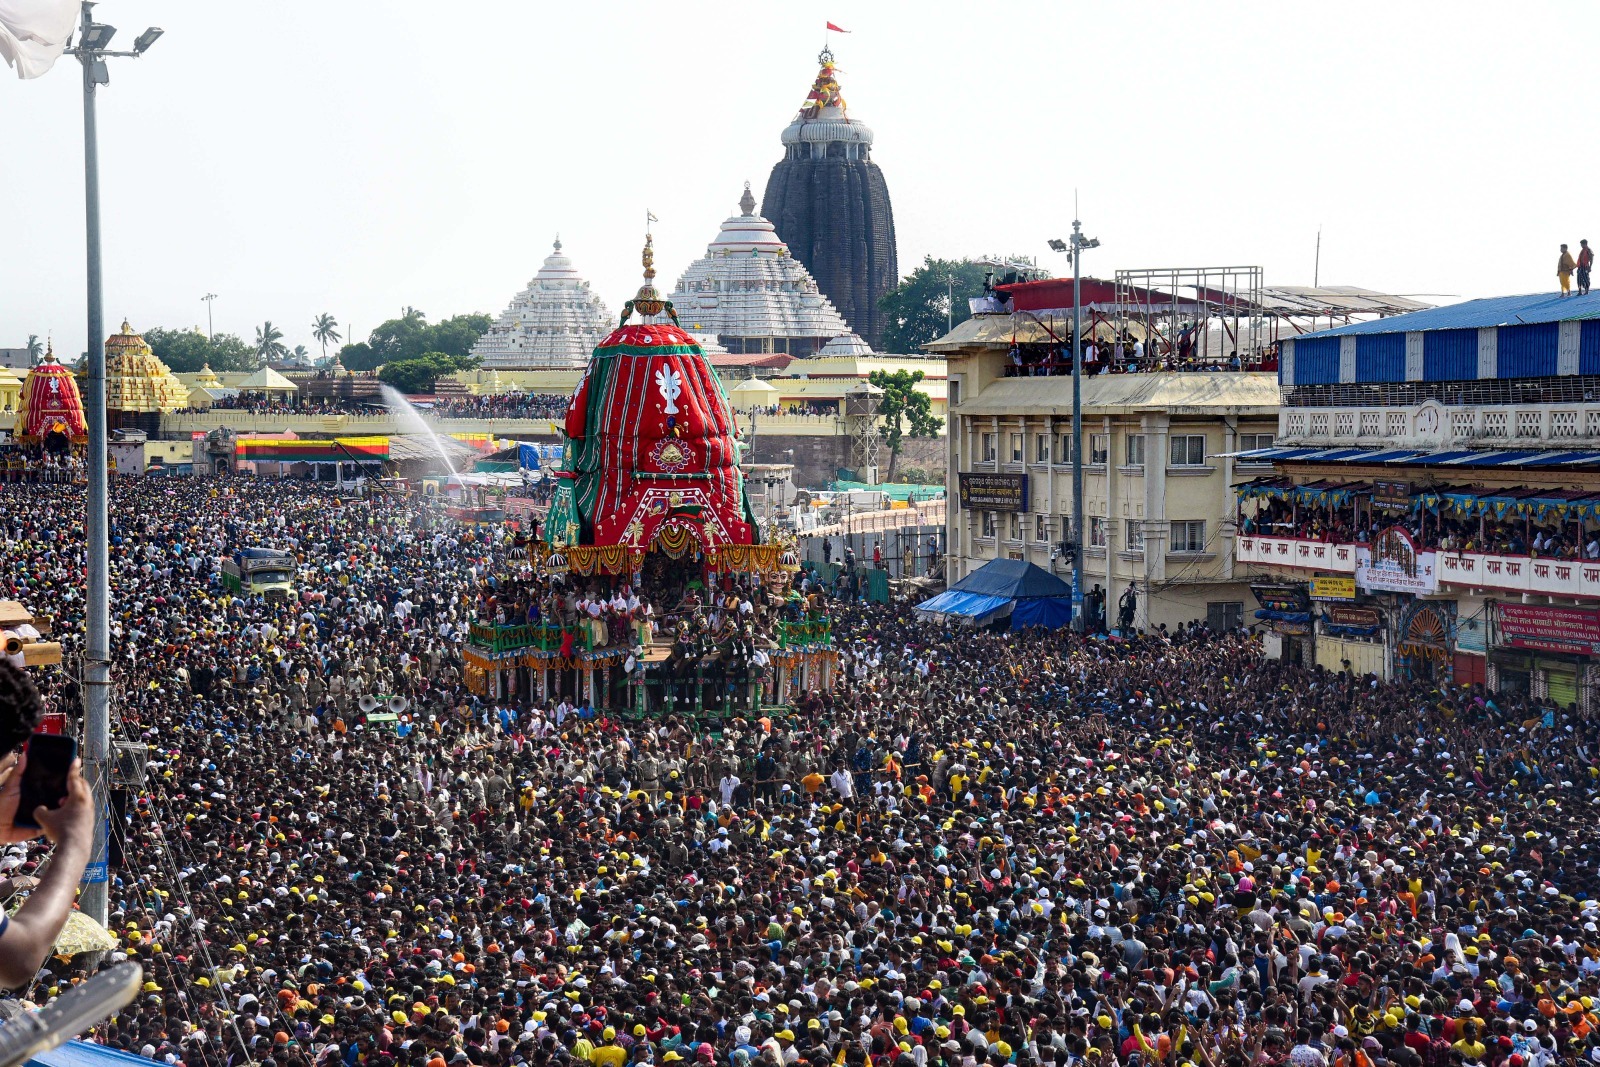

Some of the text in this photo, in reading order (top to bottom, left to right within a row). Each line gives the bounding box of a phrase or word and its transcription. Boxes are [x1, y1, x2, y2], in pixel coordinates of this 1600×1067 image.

[1242, 540, 1253, 551] राम
[1261, 542, 1288, 555] राम राम
[1299, 545, 1326, 558] राम राम
[1337, 549, 1349, 560] राम
[1445, 556, 1475, 571] राम राम
[1487, 561, 1521, 576] राम राम
[1535, 564, 1571, 580] राम राम
[1584, 568, 1600, 582] राम
